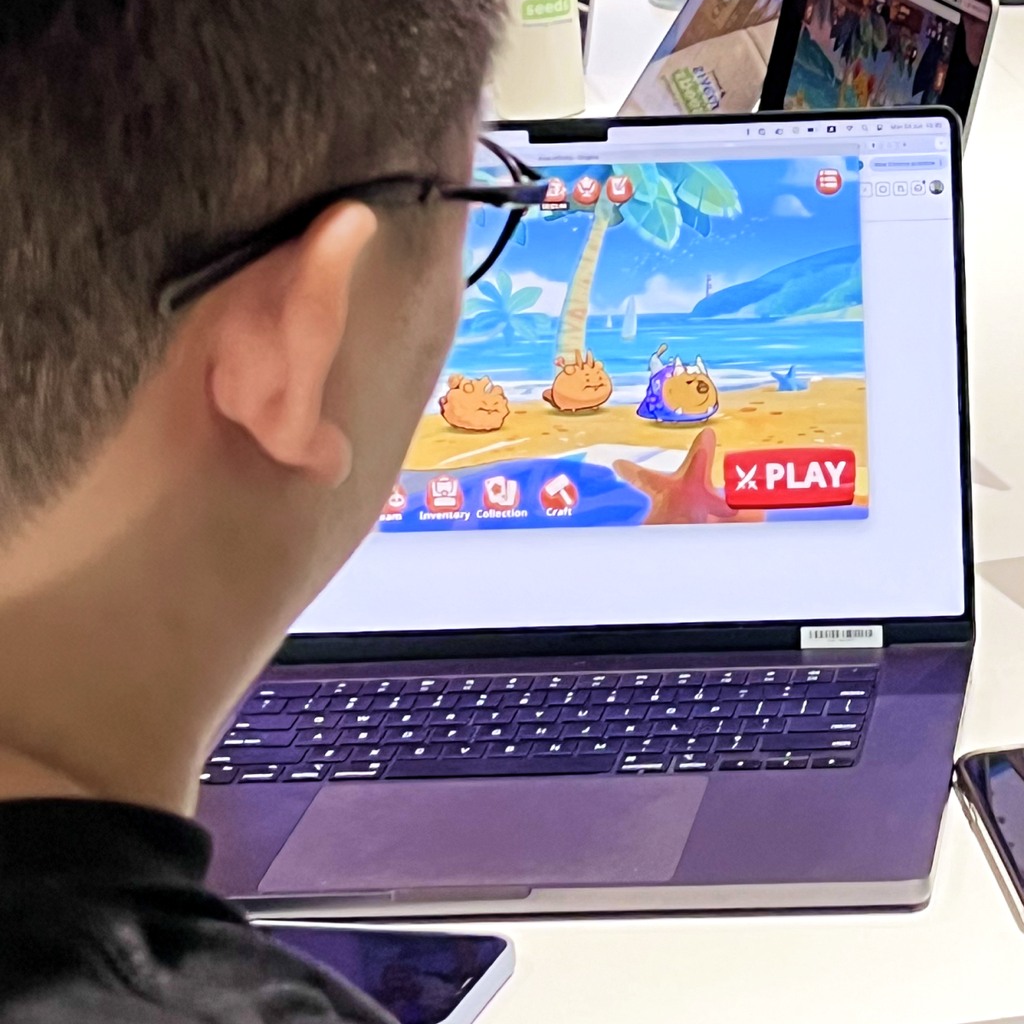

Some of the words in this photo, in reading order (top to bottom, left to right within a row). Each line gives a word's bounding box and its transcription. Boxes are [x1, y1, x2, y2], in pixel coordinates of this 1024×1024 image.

[526, 0, 569, 16] seeds
[765, 461, 847, 490] PLAY
[419, 510, 471, 521] Inventory
[476, 508, 528, 519] Collection
[546, 506, 573, 517] Craft
